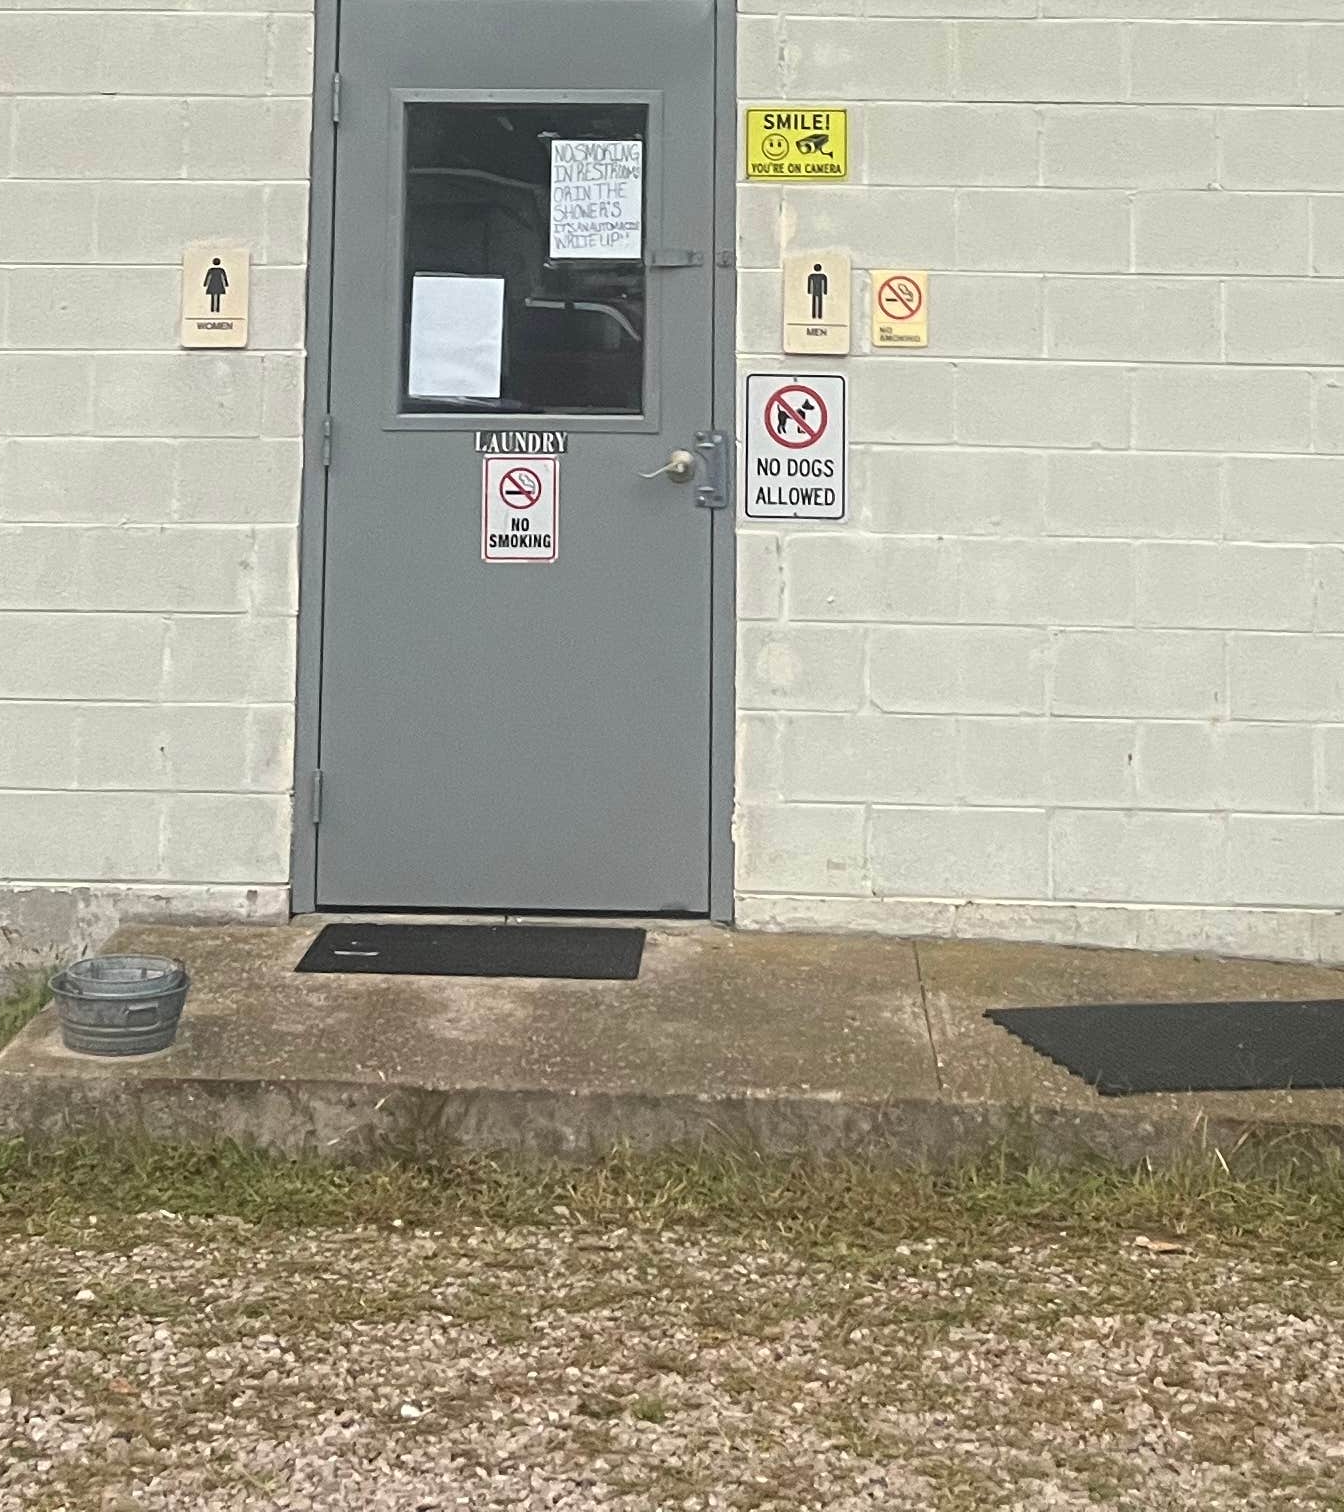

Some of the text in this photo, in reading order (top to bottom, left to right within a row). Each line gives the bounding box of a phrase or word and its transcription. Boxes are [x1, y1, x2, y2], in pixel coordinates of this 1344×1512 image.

[763, 113, 830, 130] SMILE!
[555, 142, 640, 163] NO SMOKING
[554, 165, 573, 183] IN
[751, 163, 842, 174] YOU'RE ON CAMERA
[554, 182, 627, 203] OR IN THE
[196, 321, 233, 330] WOMEN
[806, 328, 828, 336] MEN
[475, 431, 567, 453] LAUNDRY
[757, 458, 834, 477] NO DOGS
[755, 486, 836, 506] ALLOWED
[511, 517, 530, 531] NO
[488, 534, 551, 548] SMOKING
